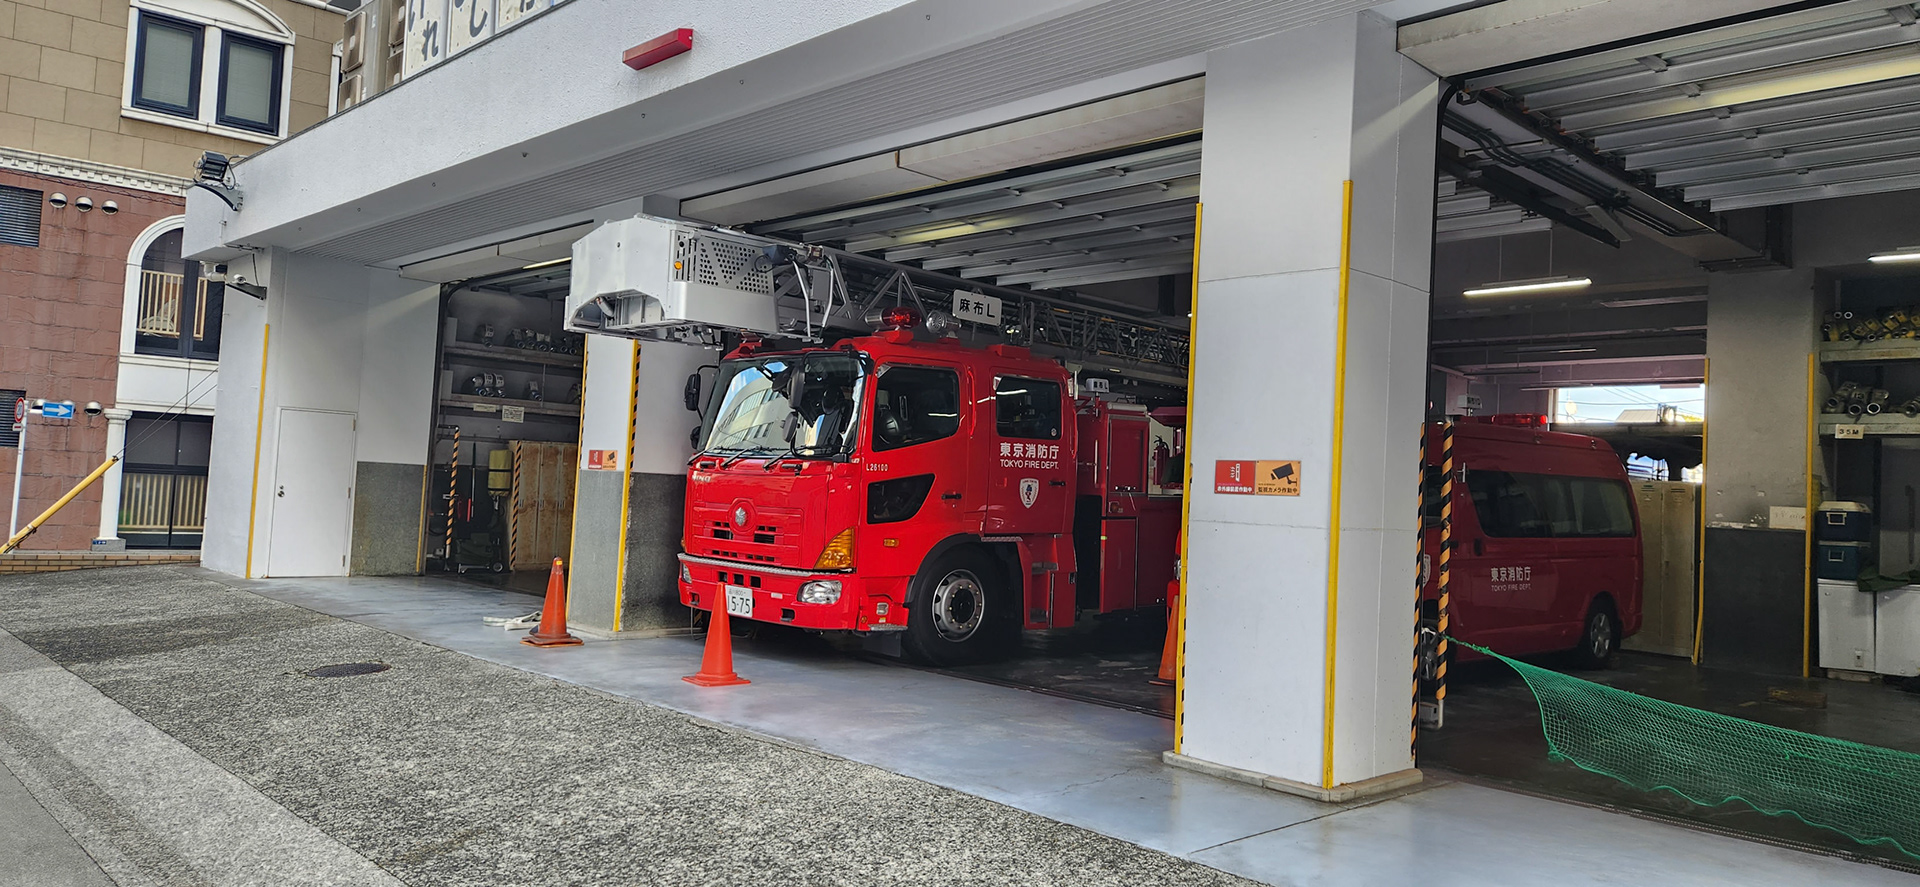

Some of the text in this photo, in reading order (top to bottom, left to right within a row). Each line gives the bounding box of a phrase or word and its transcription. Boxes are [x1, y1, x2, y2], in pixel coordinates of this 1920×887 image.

[958, 298, 996, 318] 麻布L
[999, 442, 1060, 460] 東京消防庁
[999, 459, 1059, 470] TOKYO FIRE DEPT.
[1490, 566, 1532, 582] 東京消防庁
